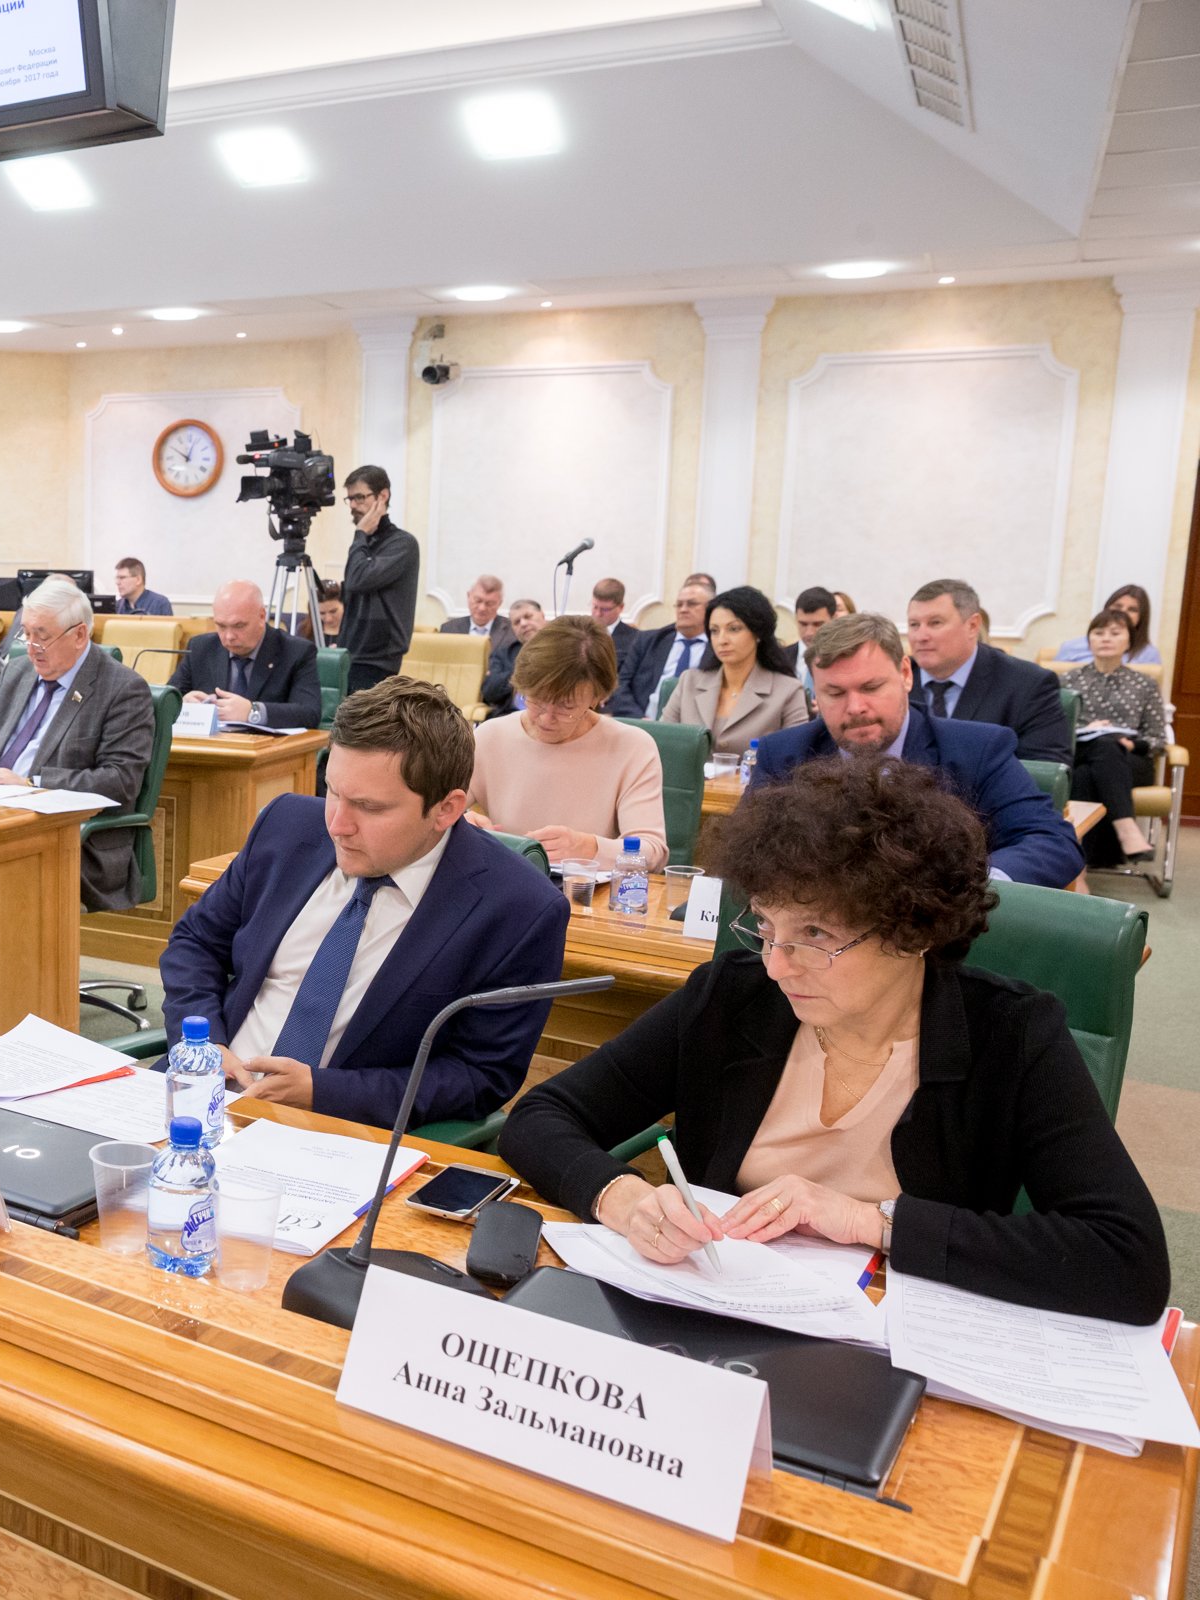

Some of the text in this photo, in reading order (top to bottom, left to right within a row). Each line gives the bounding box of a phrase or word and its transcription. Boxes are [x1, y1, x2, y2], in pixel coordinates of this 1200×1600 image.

[28, 46, 56, 56] Москва
[17, 58, 58, 71] Федерации
[24, 72, 41, 83] 2017
[43, 70, 59, 79] года
[441, 1332, 648, 1421] ОЩЕПКОВА
[392, 1361, 685, 1479] Анна Зальмановна
